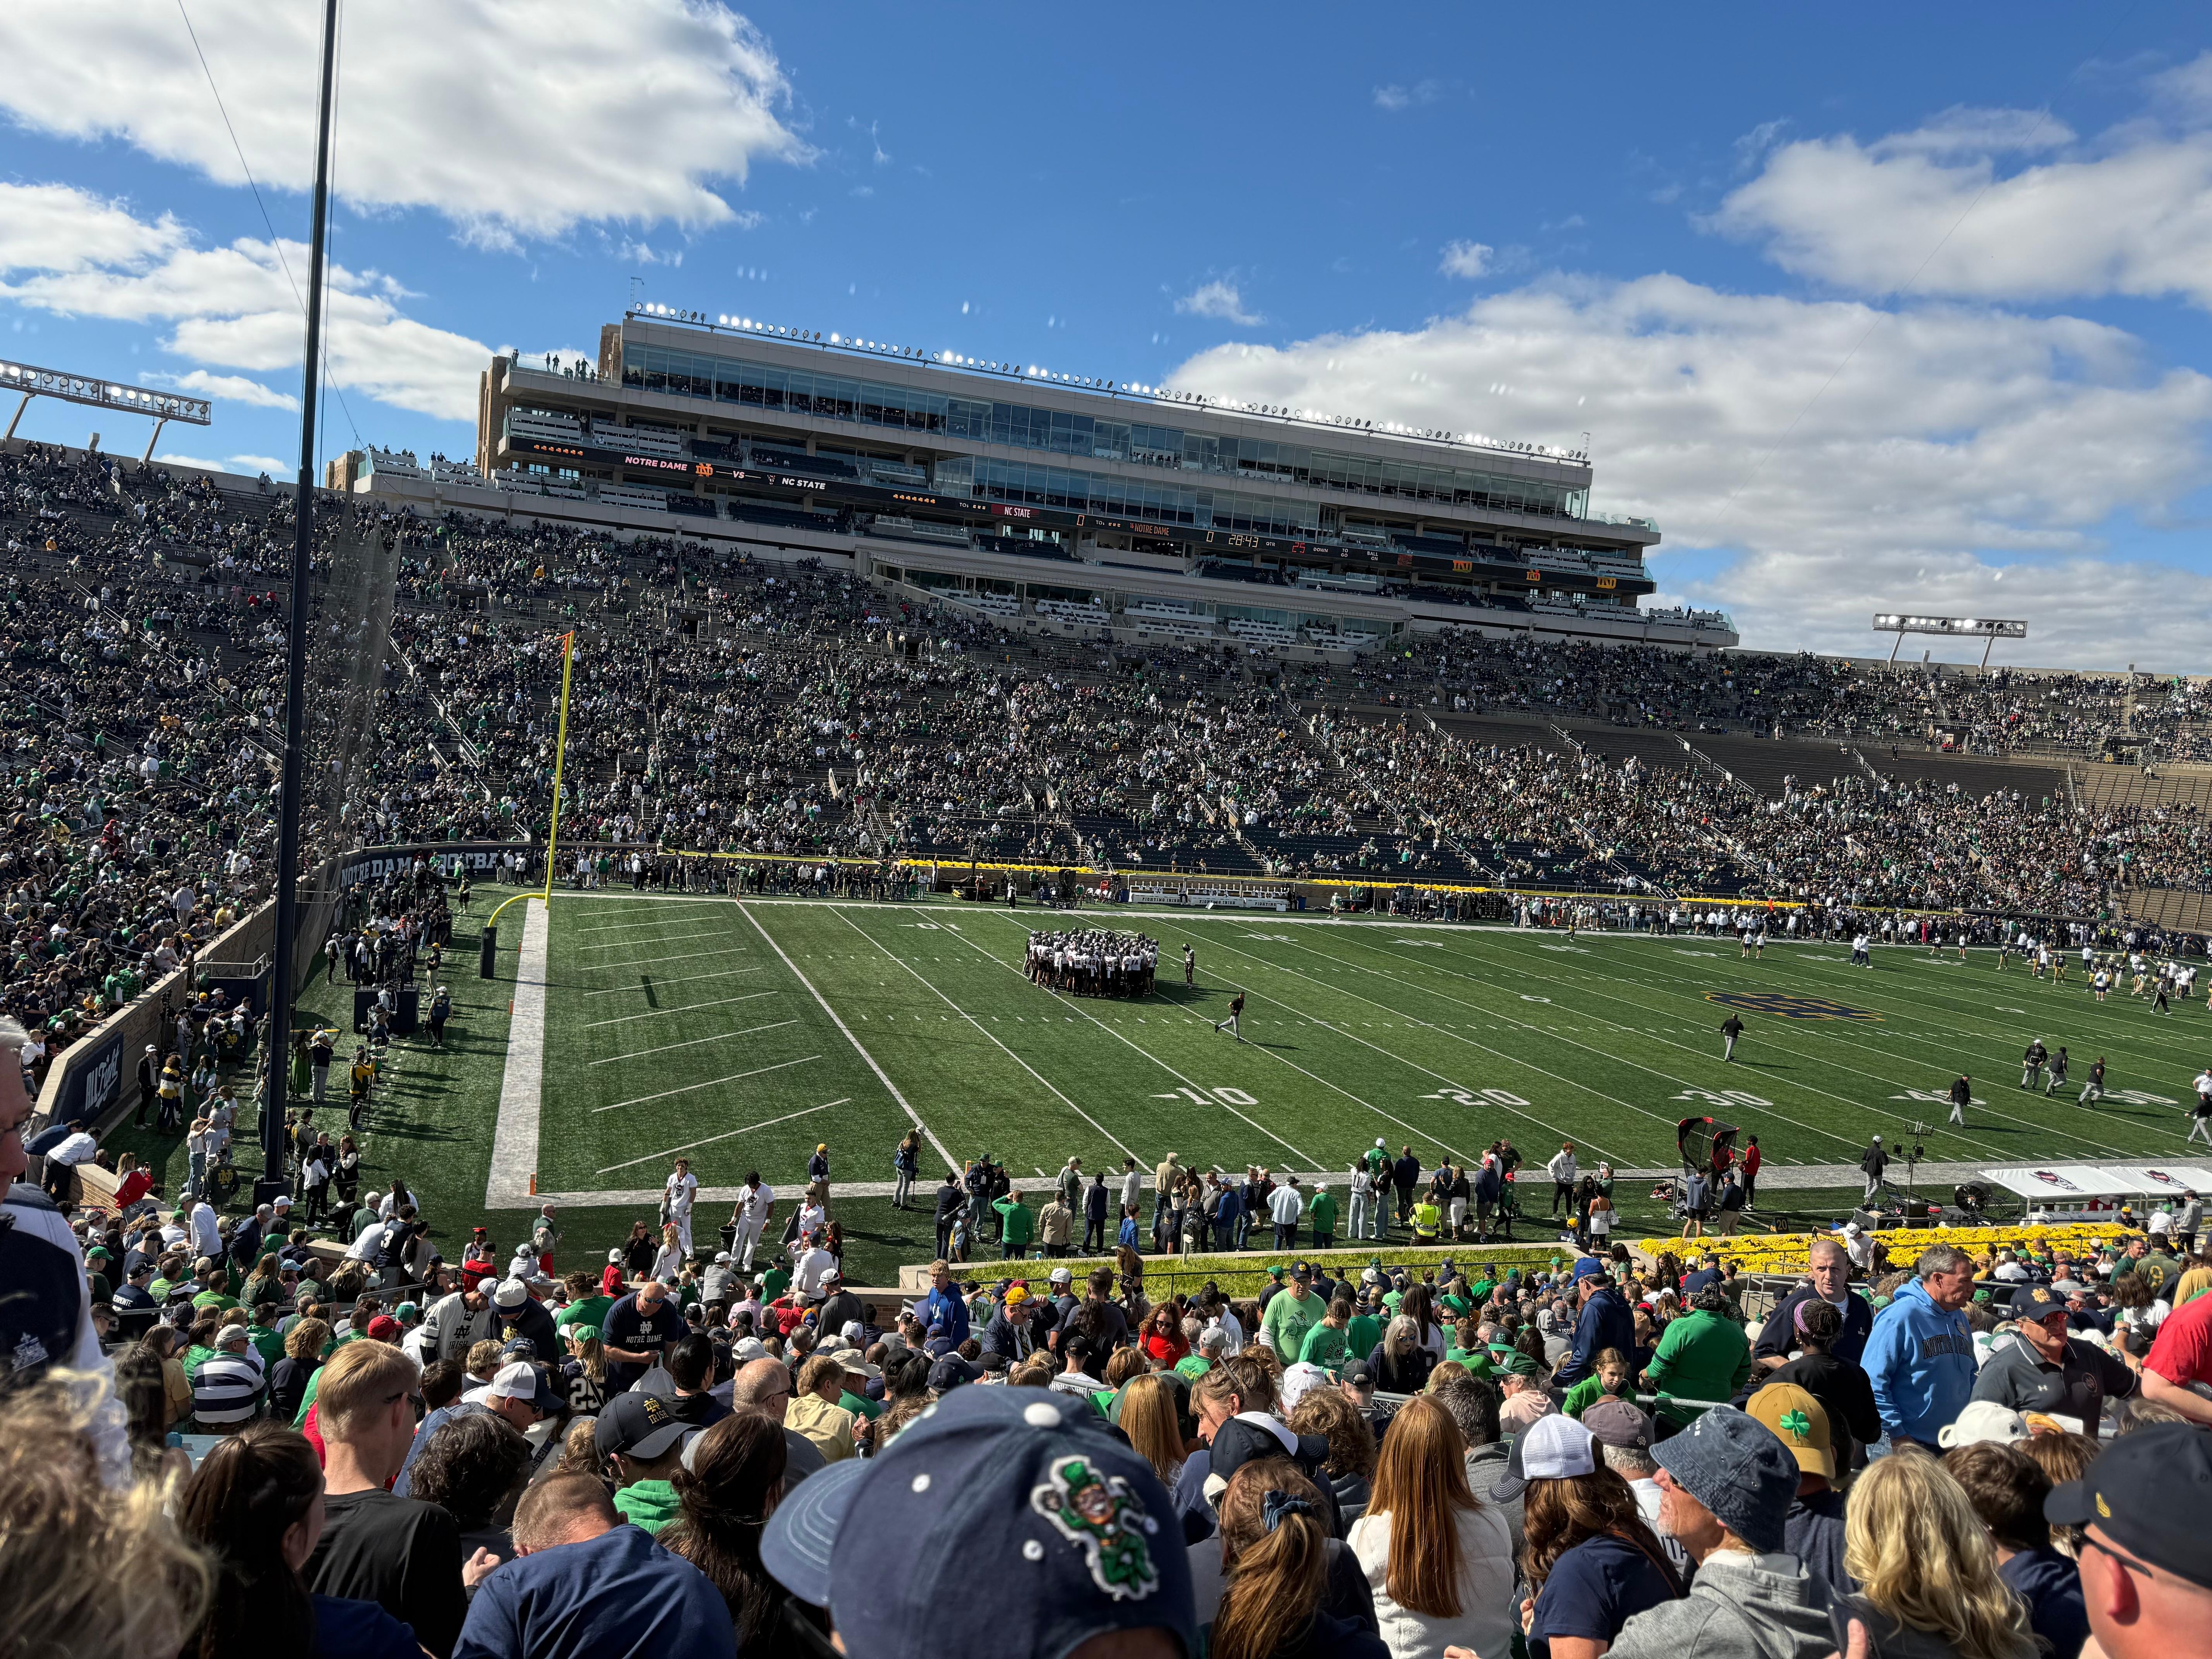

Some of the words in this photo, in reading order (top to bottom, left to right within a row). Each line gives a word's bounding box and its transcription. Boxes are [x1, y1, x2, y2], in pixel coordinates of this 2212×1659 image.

[625, 456, 658, 467] NOTRE
[660, 461, 687, 471] DAME
[733, 470, 745, 479] VS
[782, 477, 795, 486] NC
[796, 480, 826, 490] STATE
[1004, 507, 1012, 516] NC
[1014, 508, 1031, 518] STATE
[1077, 515, 1084, 526] 0
[1134, 523, 1152, 534] NOTRE
[1154, 526, 1169, 536] DAME
[1206, 531, 1214, 542] 0
[1228, 534, 1259, 548] 28:43
[1292, 542, 1306, 553] 25
[341, 861, 370, 887] NOTRE
[371, 856, 412, 877] DAM
[85, 1067, 98, 1111] ALL
[95, 1043, 120, 1109] Fight
[1175, 1087, 1260, 1105] 10
[1438, 1088, 1531, 1106] 20
[1682, 1090, 1773, 1106] 30
[1776, 1219, 1787, 1230] 20
[380, 1229, 394, 1248] 3
[2150, 1265, 2163, 1286] 9
[448, 1340, 469, 1349] IRISH
[646, 1334, 662, 1343] DAME
[569, 1377, 605, 1411] 25
[649, 1410, 669, 1425] IRISH
